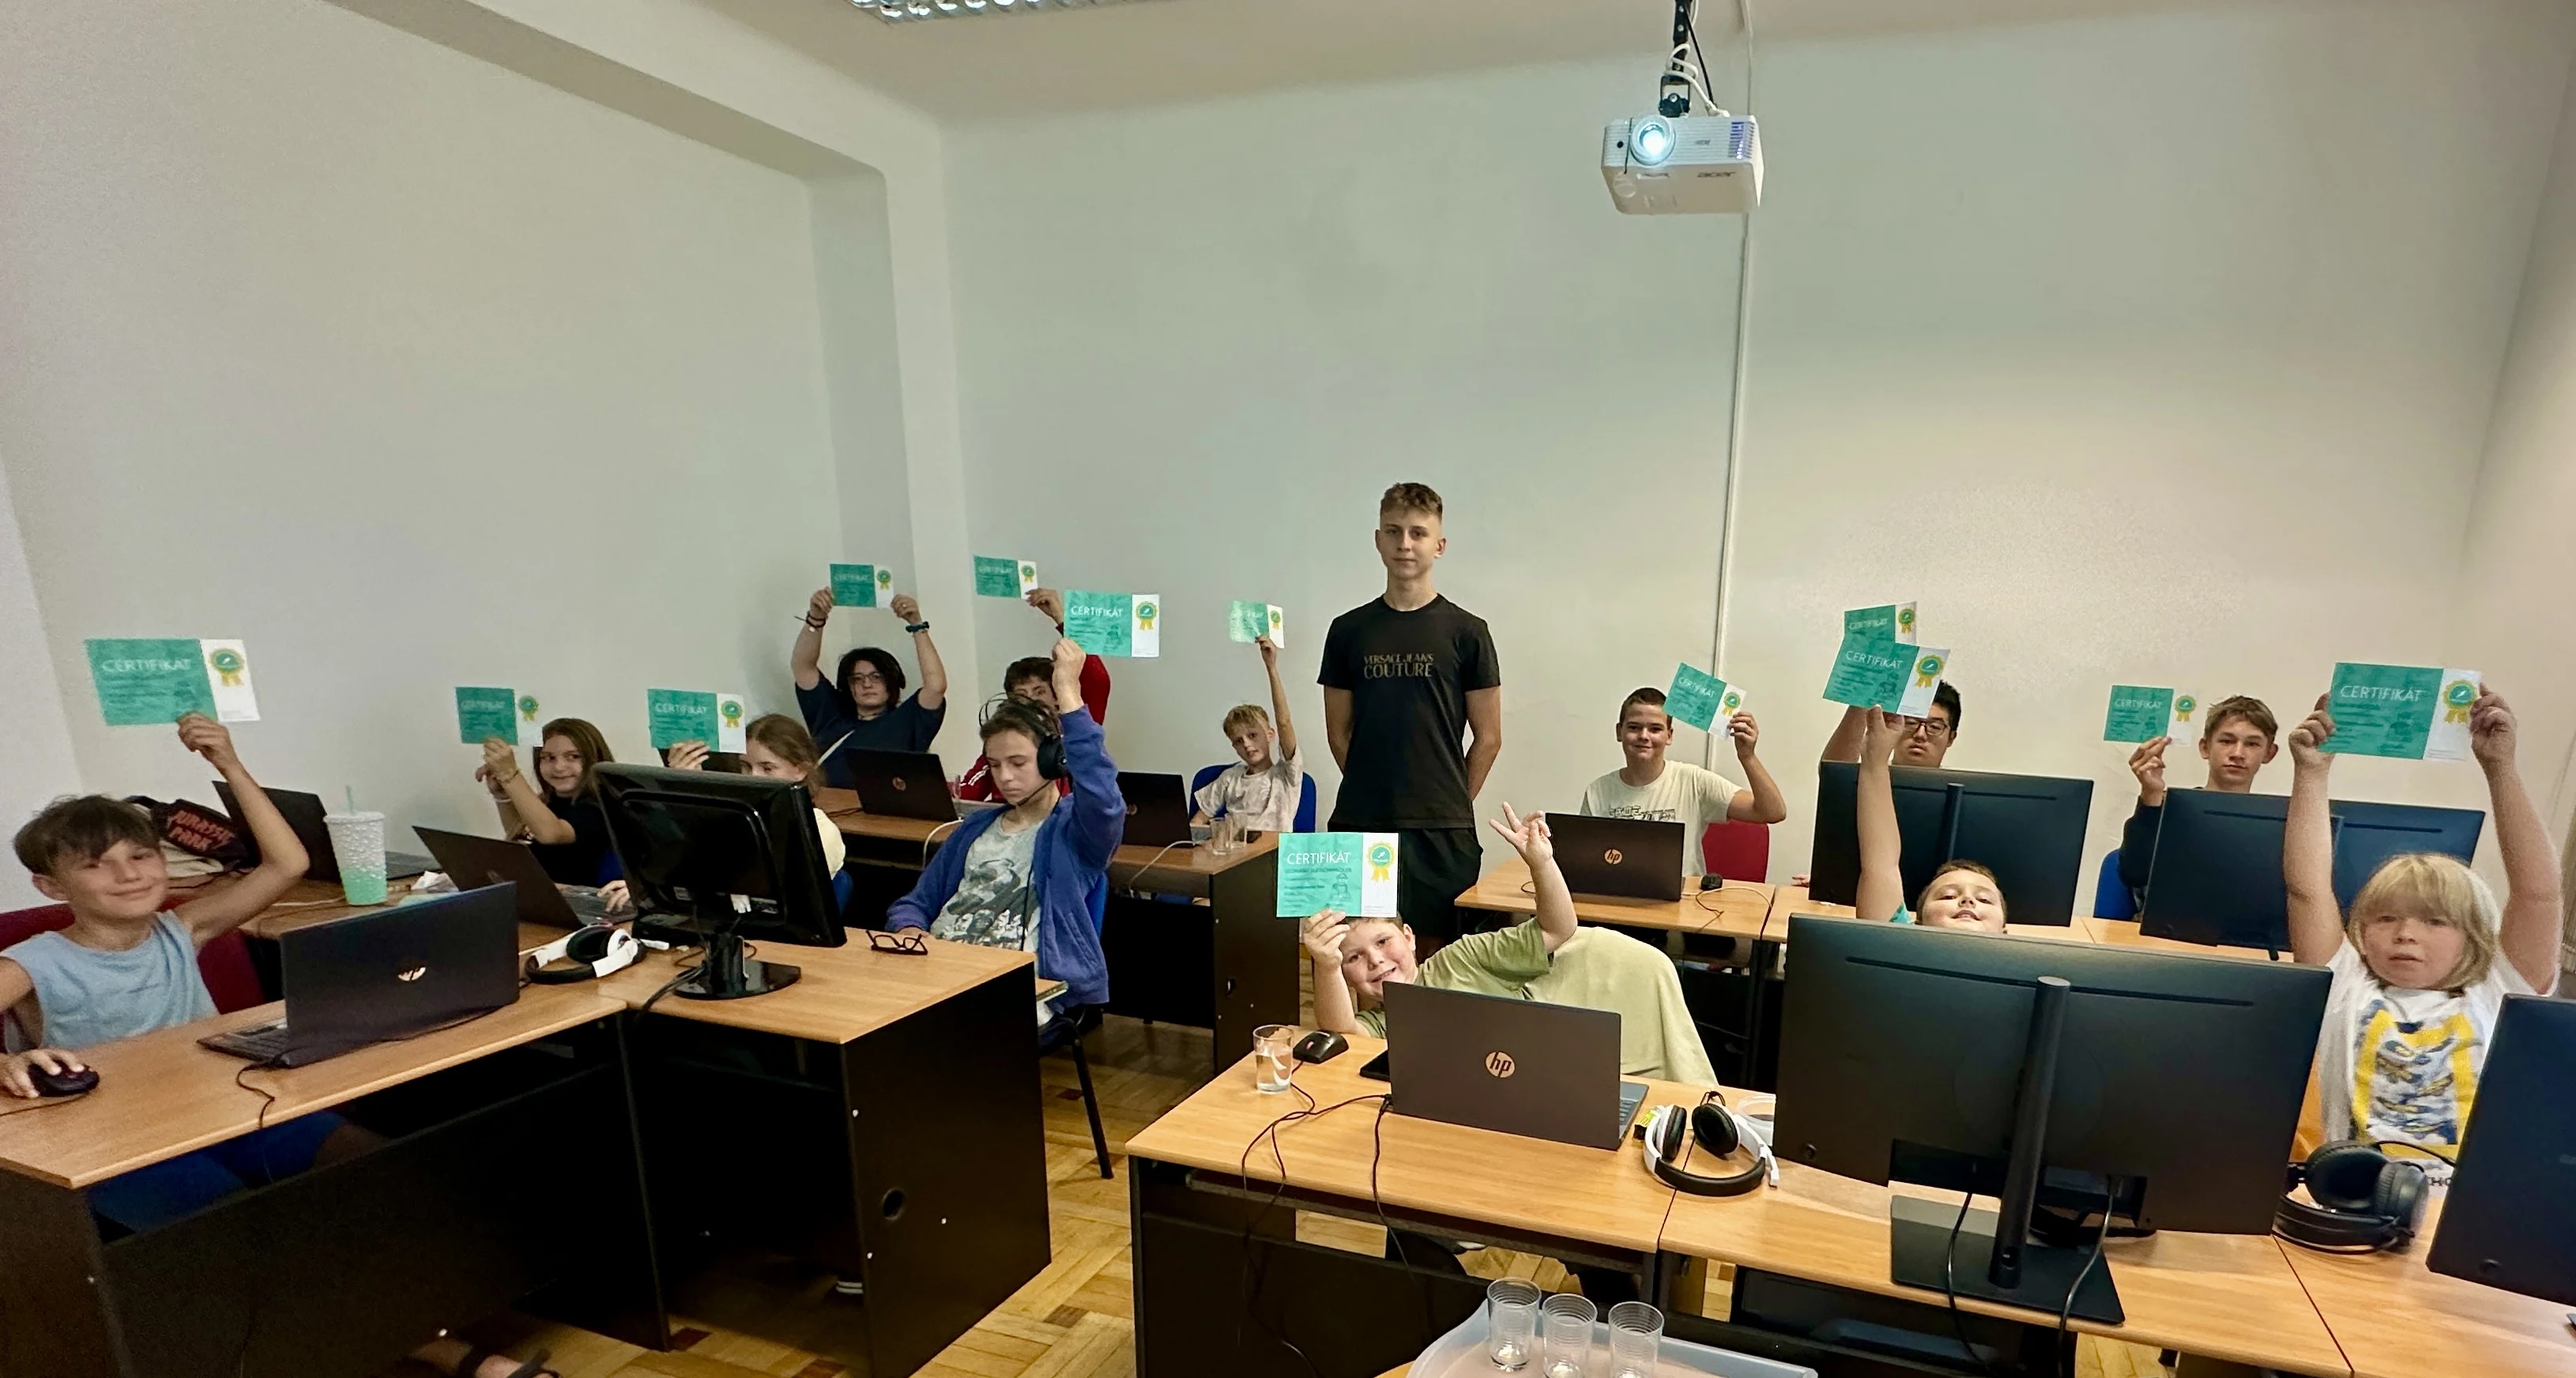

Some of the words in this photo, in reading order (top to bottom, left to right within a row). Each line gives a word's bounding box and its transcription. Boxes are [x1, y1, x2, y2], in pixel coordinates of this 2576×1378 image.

[1364, 663, 1433, 679] COUTURE
[1606, 849, 1621, 865] hp
[1488, 1051, 1512, 1078] hp
